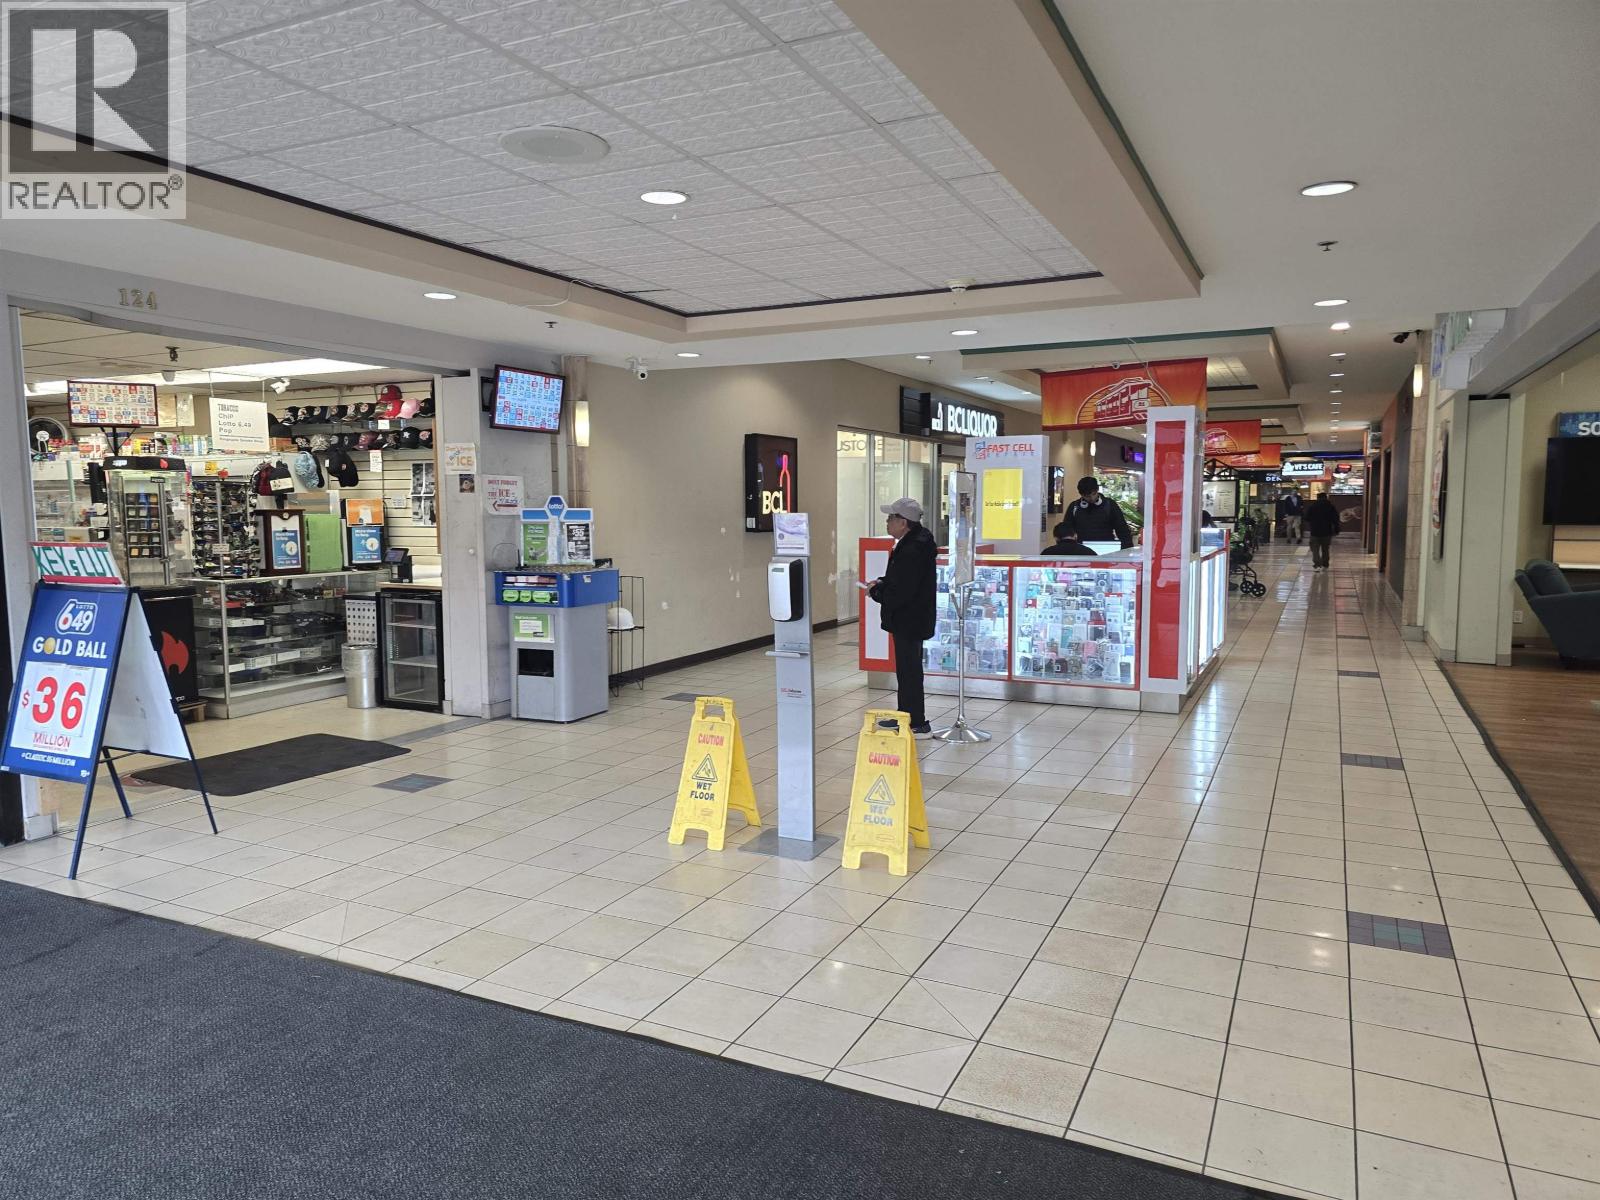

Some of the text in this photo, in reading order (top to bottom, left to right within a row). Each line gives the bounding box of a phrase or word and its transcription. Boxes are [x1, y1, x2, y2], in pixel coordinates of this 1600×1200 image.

[118, 287, 158, 310] 124
[987, 443, 1035, 453] FAST CELL
[456, 455, 473, 467] ICE
[498, 488, 511, 498] ICE
[762, 490, 788, 515] BCL
[32, 636, 108, 659] GOLD BALL
[33, 731, 72, 748] MILLION
[697, 733, 725, 747] CAUTION
[868, 751, 902, 767] CAUTION
[696, 781, 713, 791] WET
[690, 790, 715, 801] FLOOR
[869, 804, 889, 816] WET
[863, 813, 893, 827] FLOOR
